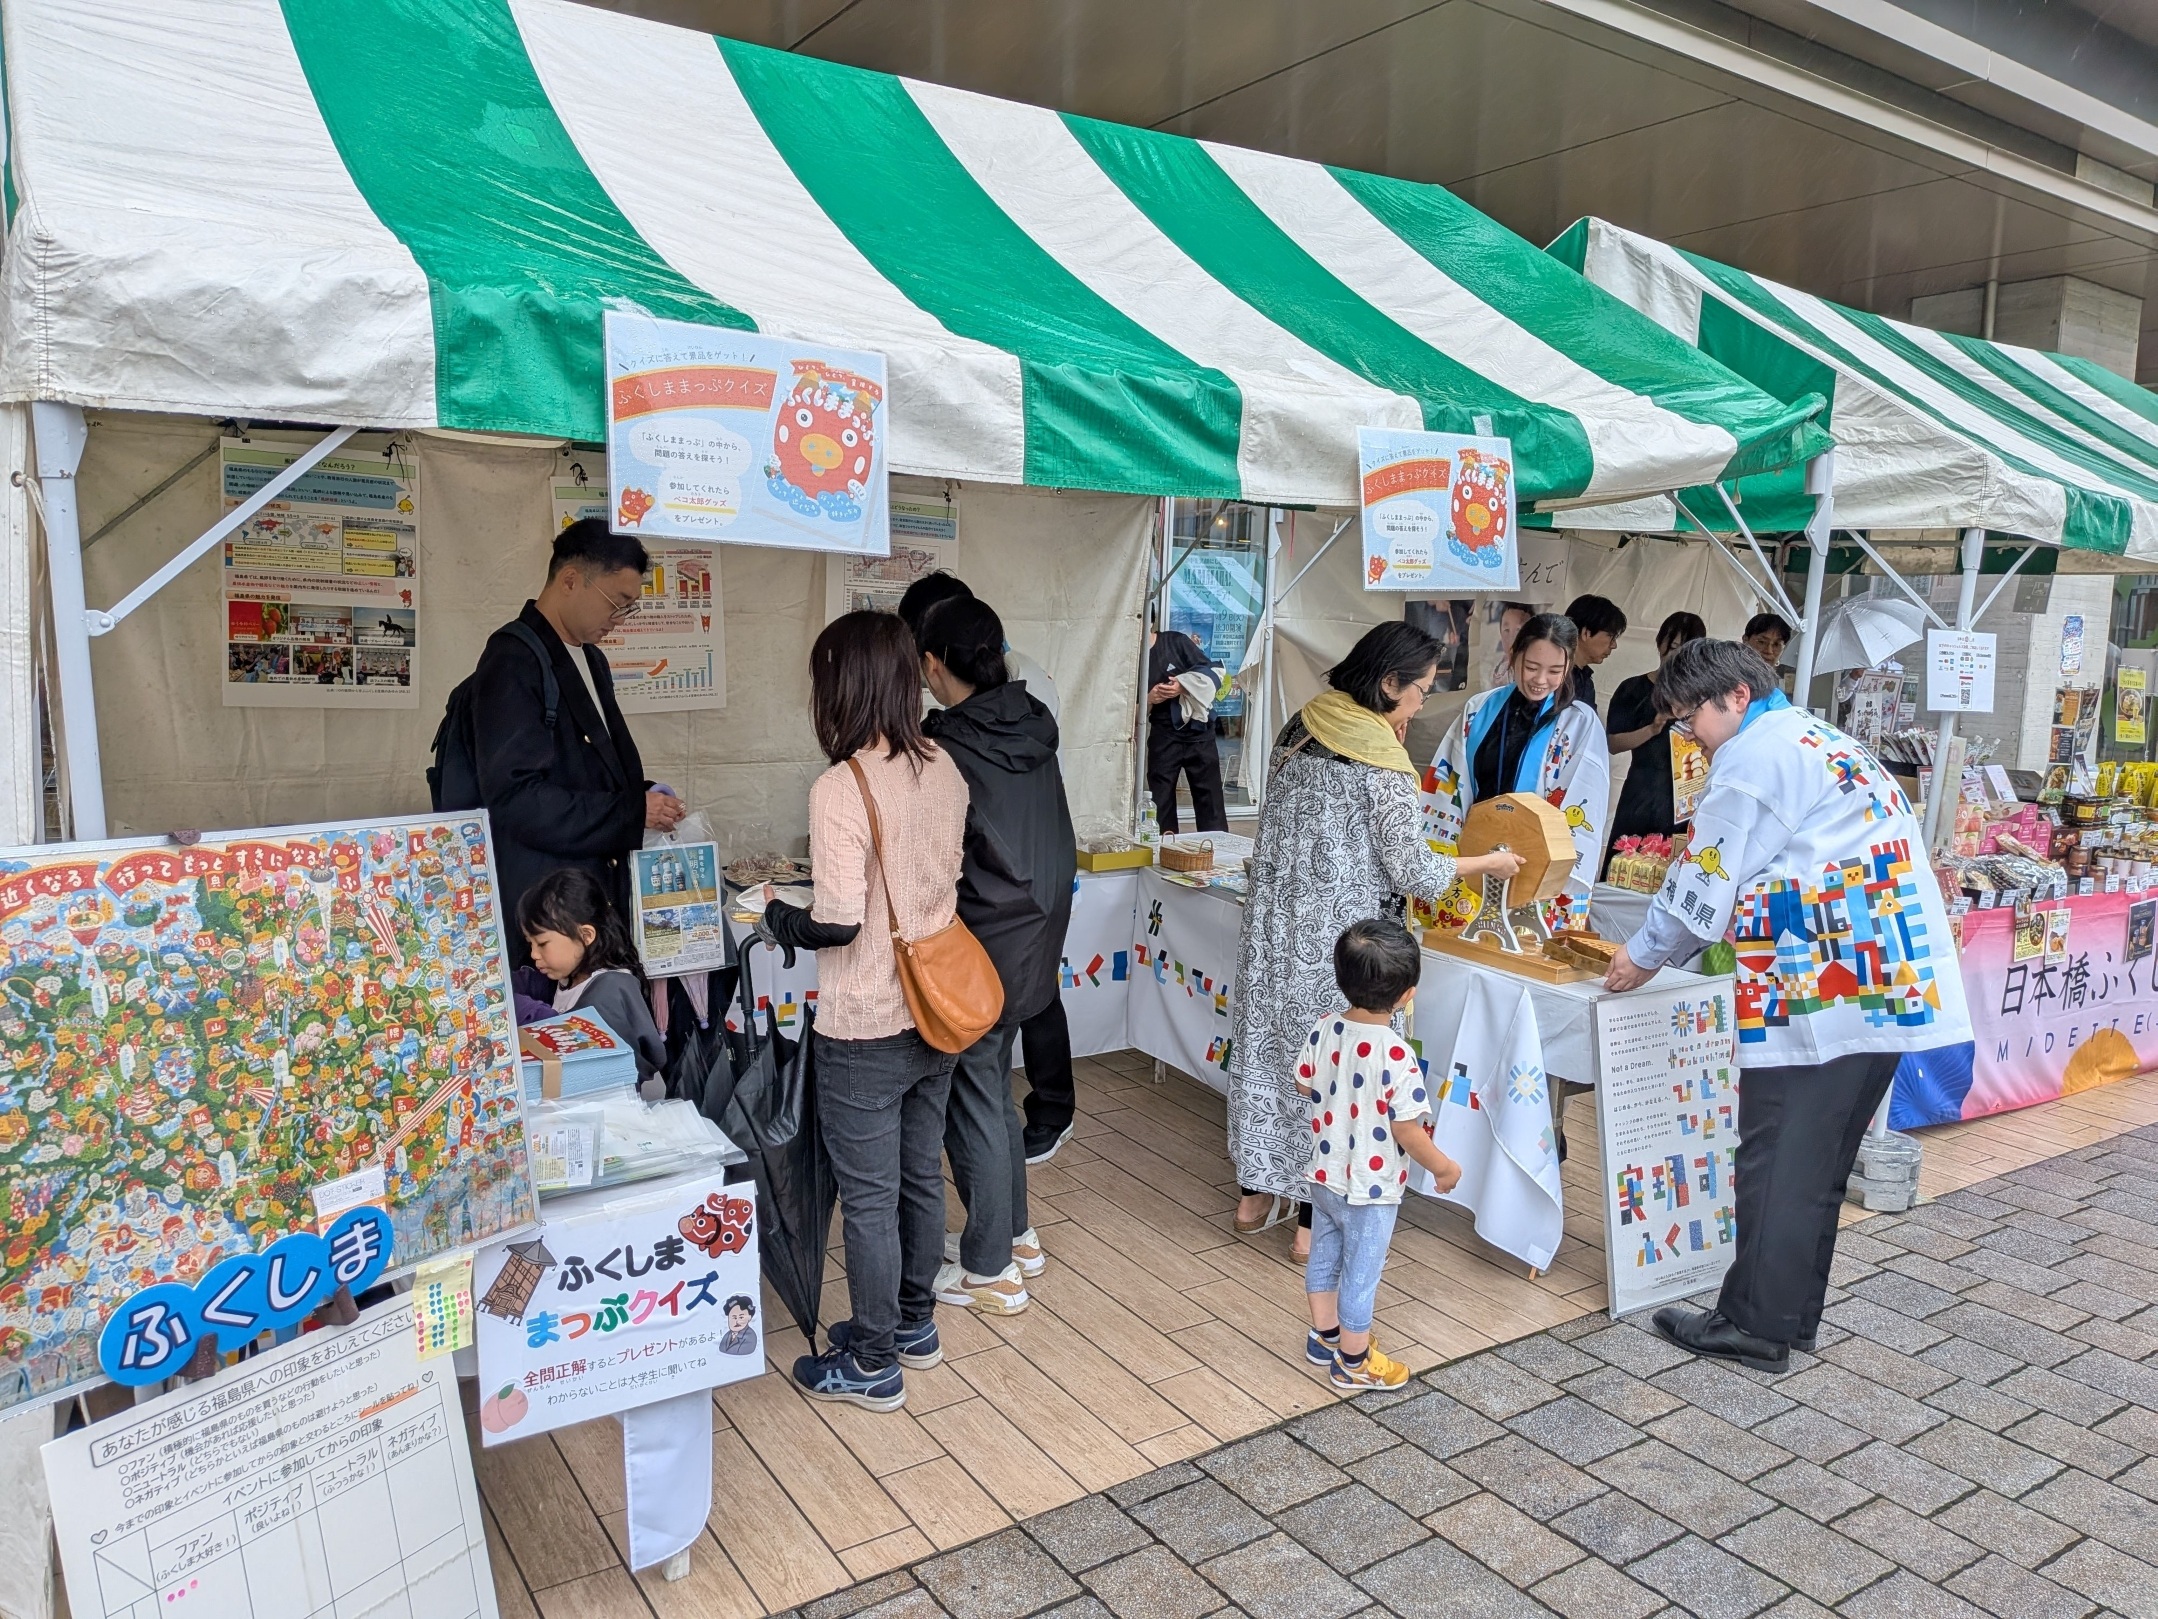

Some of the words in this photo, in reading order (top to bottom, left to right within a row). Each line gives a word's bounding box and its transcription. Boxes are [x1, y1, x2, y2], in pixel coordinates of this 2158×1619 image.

[618, 379, 768, 404] ふくしままっぷクイズ
[654, 449, 729, 465] 問題の答えを探そう！
[669, 482, 730, 495] 参加してくれたら
[1365, 467, 1448, 495] ふくしままっぷクイズ
[674, 514, 723, 526] をプレゼント。
[116, 860, 172, 887] 行って
[184, 854, 224, 873] もっと
[235, 847, 283, 868] すきに
[210, 1022, 222, 1032] 山
[1611, 1063, 1624, 1075] Not
[1630, 1060, 1654, 1070] Dream.
[557, 1235, 687, 1292] ふくしま
[118, 1217, 382, 1370] ふくしま
[526, 1270, 719, 1349] まっぷクイズ
[522, 1328, 724, 1389] 全問正解するとプレゼントがあるよ！
[101, 1308, 416, 1459] あなたが感じる福島県への印象をおしえてください
[547, 1357, 708, 1406] わからないことは大学生に聞いてね
[386, 1413, 438, 1449] ネガティブ
[222, 1417, 385, 1507] イベントに参加してからの印象
[315, 1446, 379, 1486] ニュートラル
[243, 1484, 304, 1524] ポジティブ
[175, 1530, 215, 1559] ファン
